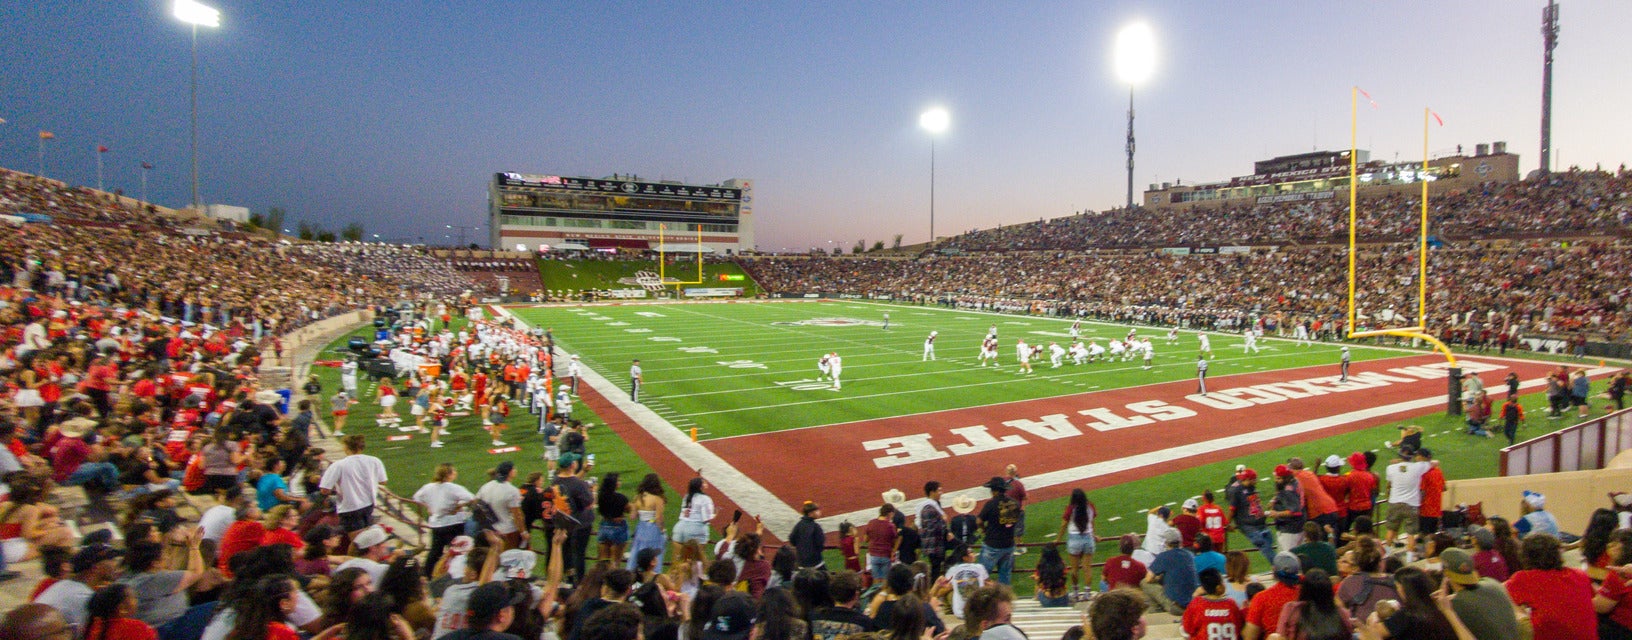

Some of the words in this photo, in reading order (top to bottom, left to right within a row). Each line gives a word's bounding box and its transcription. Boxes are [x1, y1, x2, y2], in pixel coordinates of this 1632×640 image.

[1272, 169, 1316, 178] MEXICO
[1322, 165, 1365, 173] STAE
[1185, 371, 1393, 411] MEXICO
[861, 399, 1199, 469] STATE
[1207, 622, 1236, 640] 89
